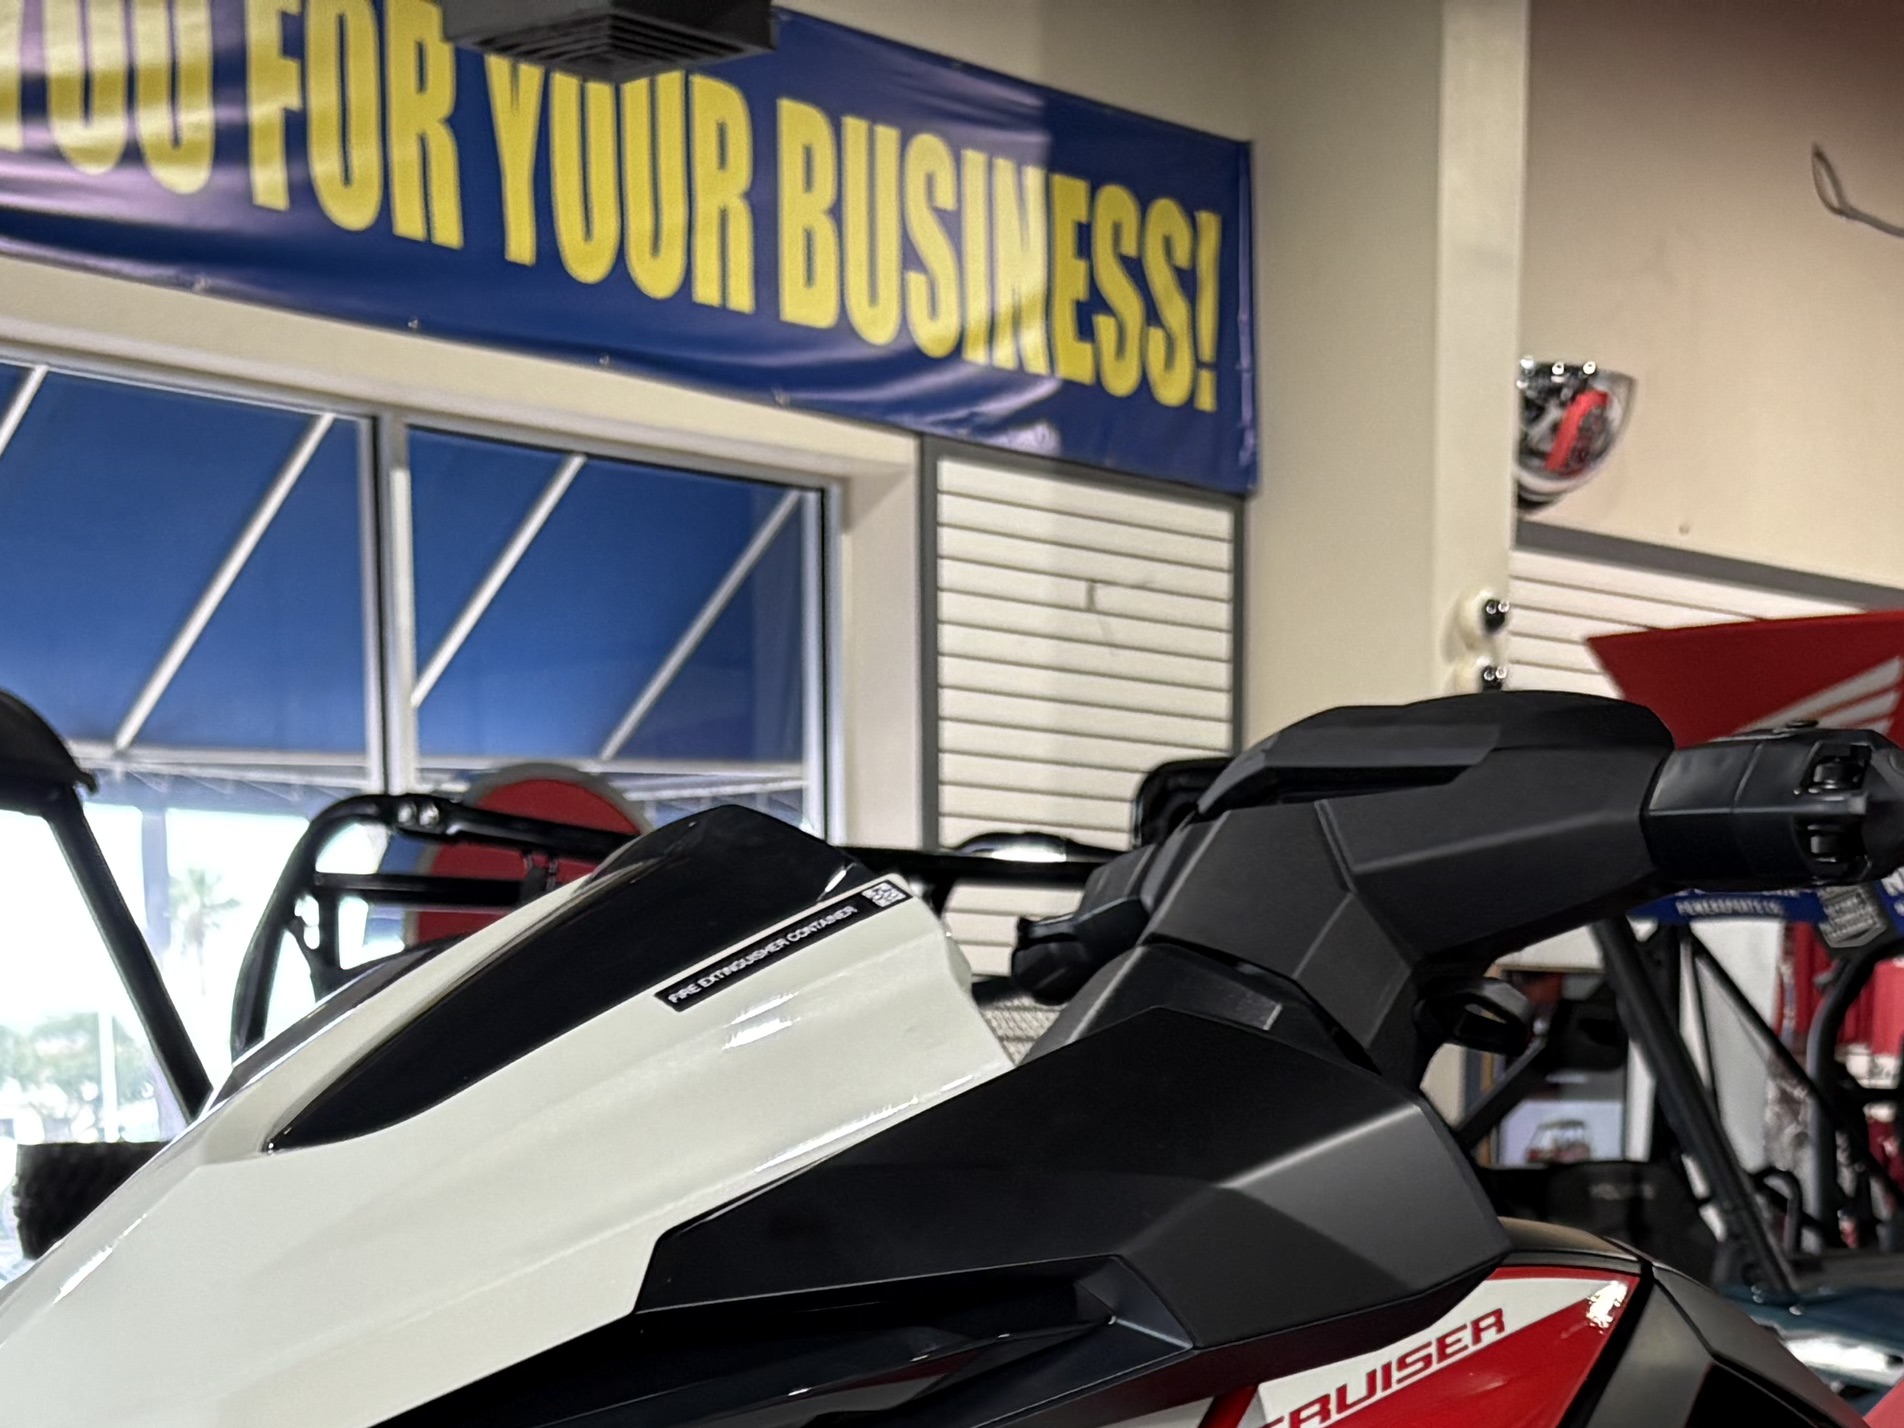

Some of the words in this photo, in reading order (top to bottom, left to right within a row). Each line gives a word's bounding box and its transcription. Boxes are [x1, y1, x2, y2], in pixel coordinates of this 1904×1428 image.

[241, 0, 465, 250] FOR
[484, 53, 757, 316] YOUR
[777, 97, 1222, 412] BUSINESS!
[667, 981, 699, 1004] FIRE
[698, 938, 789, 990] EXTINGUISHER
[787, 904, 858, 943] CONTAINER
